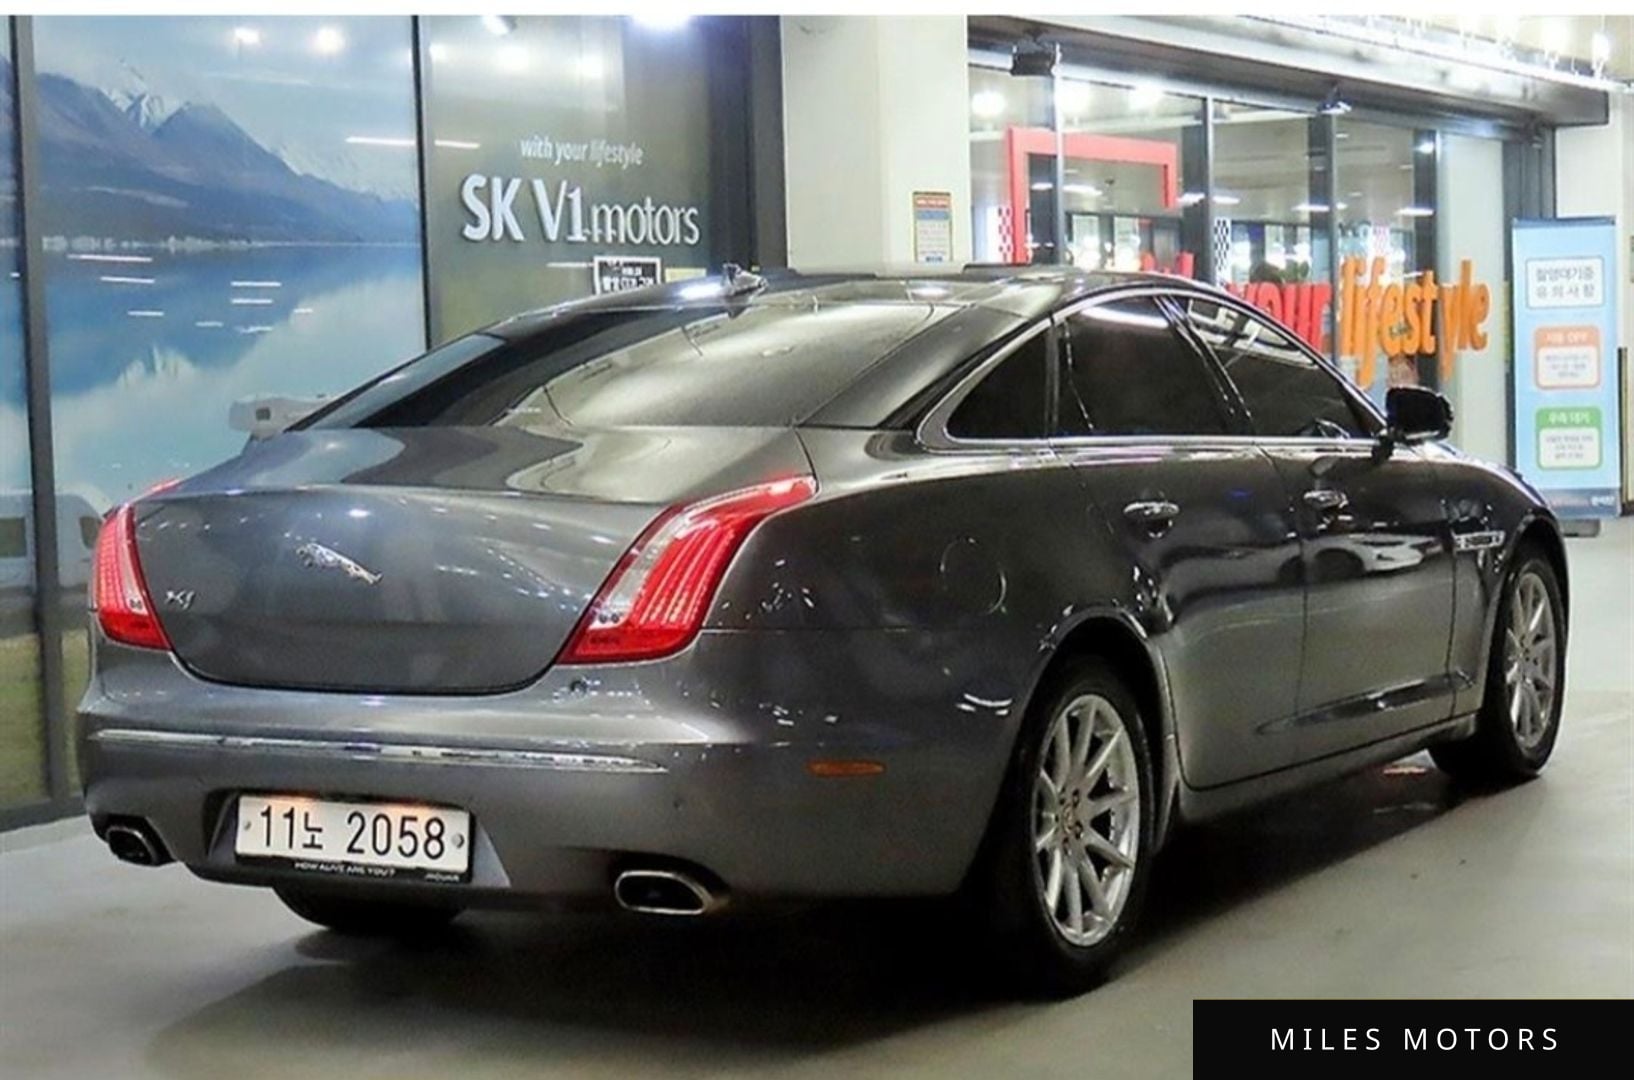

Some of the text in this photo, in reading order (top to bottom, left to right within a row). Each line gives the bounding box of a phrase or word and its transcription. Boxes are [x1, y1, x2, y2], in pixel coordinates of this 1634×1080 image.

[521, 135, 645, 171] with your lifestyle
[461, 173, 525, 242] SK
[260, 804, 446, 861] 11노 2058
